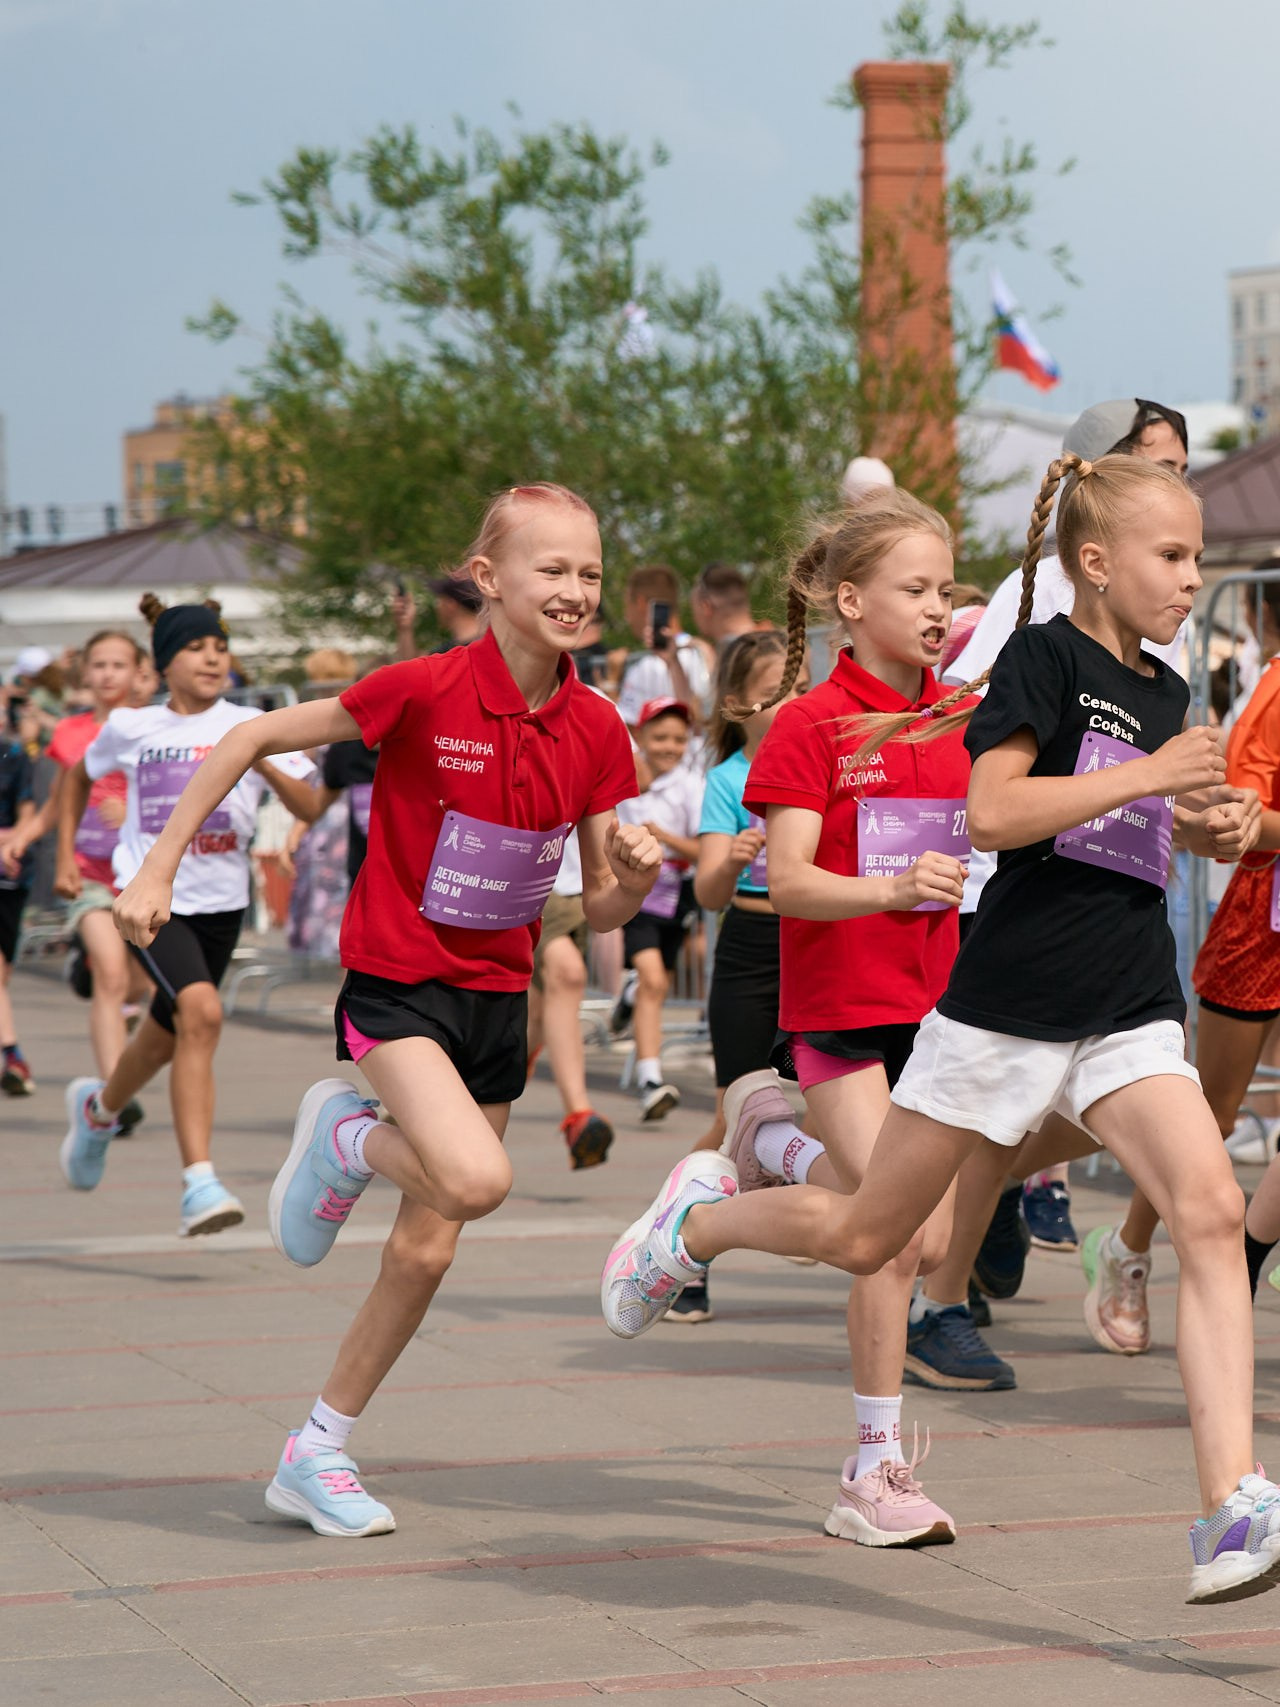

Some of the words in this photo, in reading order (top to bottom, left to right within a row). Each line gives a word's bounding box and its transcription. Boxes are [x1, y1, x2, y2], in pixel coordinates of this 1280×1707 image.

[1078, 693, 1142, 732] Семенова
[1089, 714, 1134, 744] Софья
[433, 735, 494, 756] ЧЕМАГИНА
[438, 756, 484, 774] КСЕНИЯ
[837, 752, 885, 770] ПОВА
[840, 769, 888, 788] ПОЛИНА
[952, 809, 968, 836] 27
[1122, 809, 1149, 829] ЗАБЕГ
[536, 834, 564, 864] 280
[865, 853, 909, 868] ДЕТСКИЙ
[431, 879, 450, 895] 500
[450, 886, 462, 898] М
[434, 865, 481, 888] ДЕТСКИЙ
[480, 878, 510, 892] ЗАБЕГ
